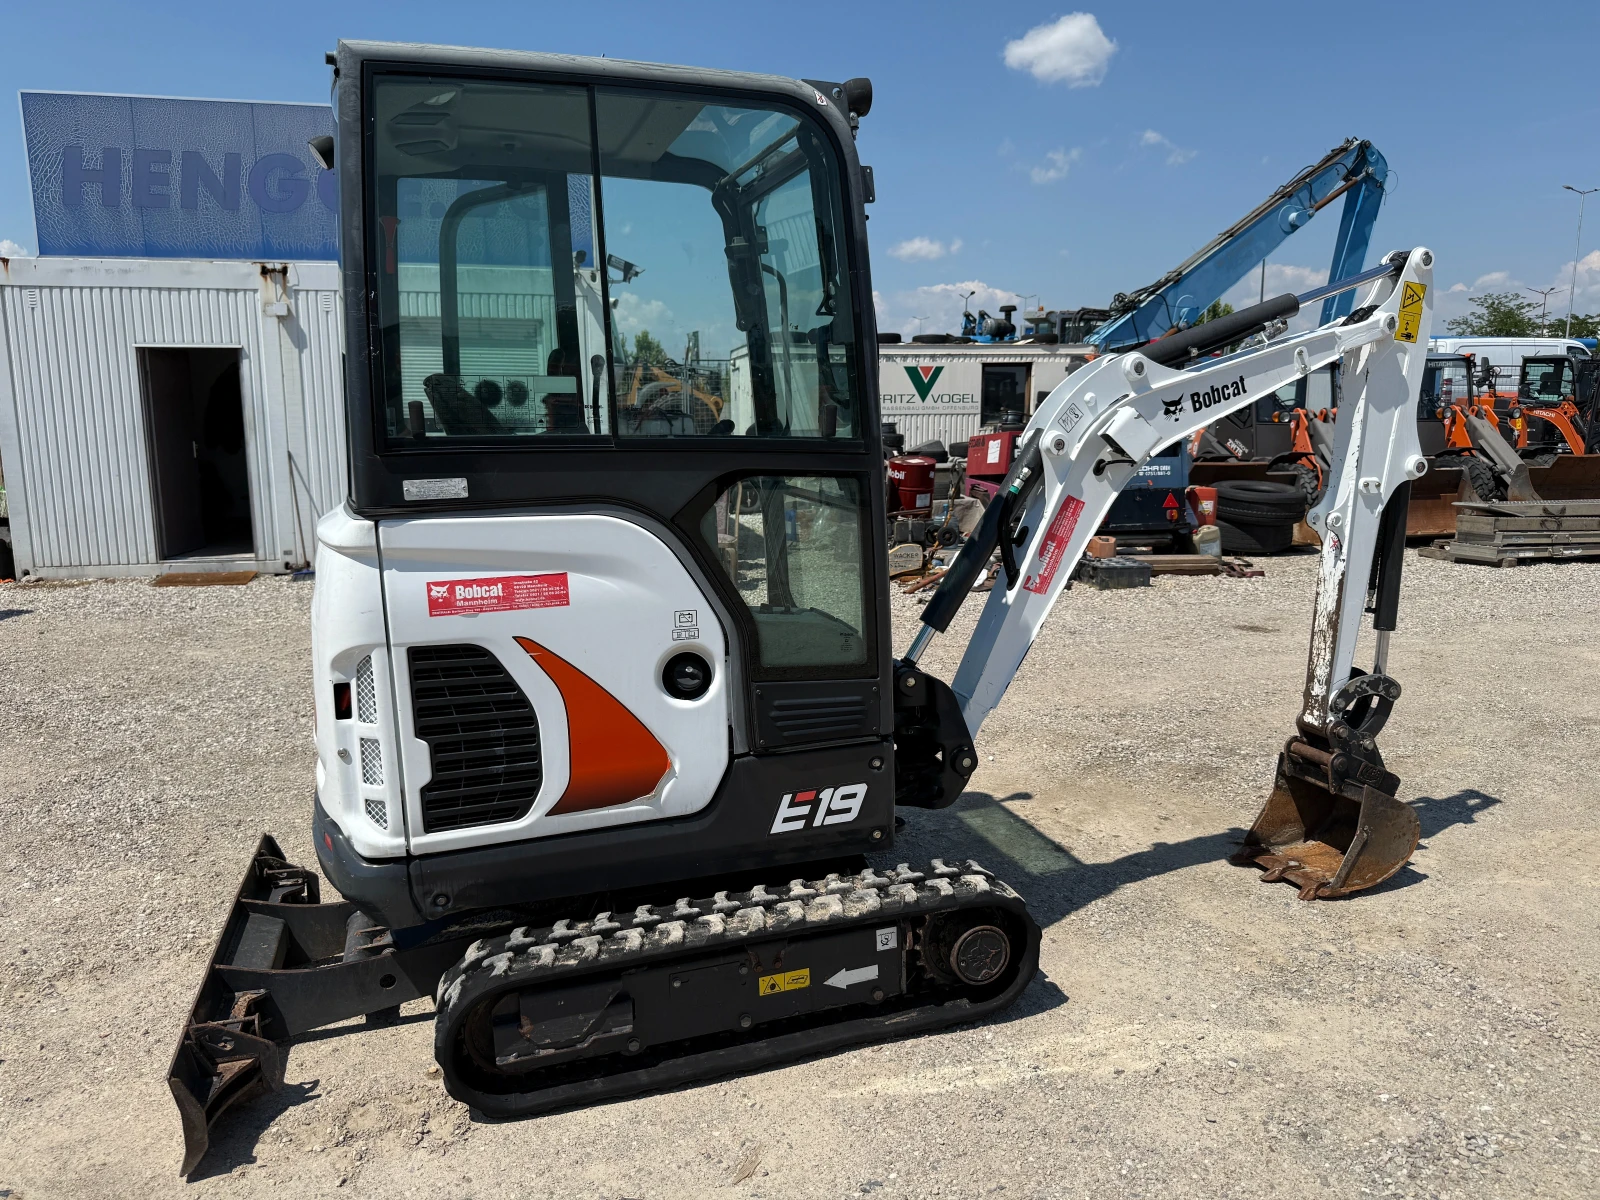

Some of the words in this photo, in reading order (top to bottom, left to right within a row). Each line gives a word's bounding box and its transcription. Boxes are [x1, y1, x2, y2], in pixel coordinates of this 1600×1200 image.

[63, 146, 337, 213] HENG
[880, 393, 916, 404] RITZ
[931, 393, 979, 404] VOGEL
[1190, 375, 1247, 413] Bobcat
[455, 582, 504, 600] Bobcat
[456, 598, 498, 607] Mannheim
[769, 782, 868, 835] E19
